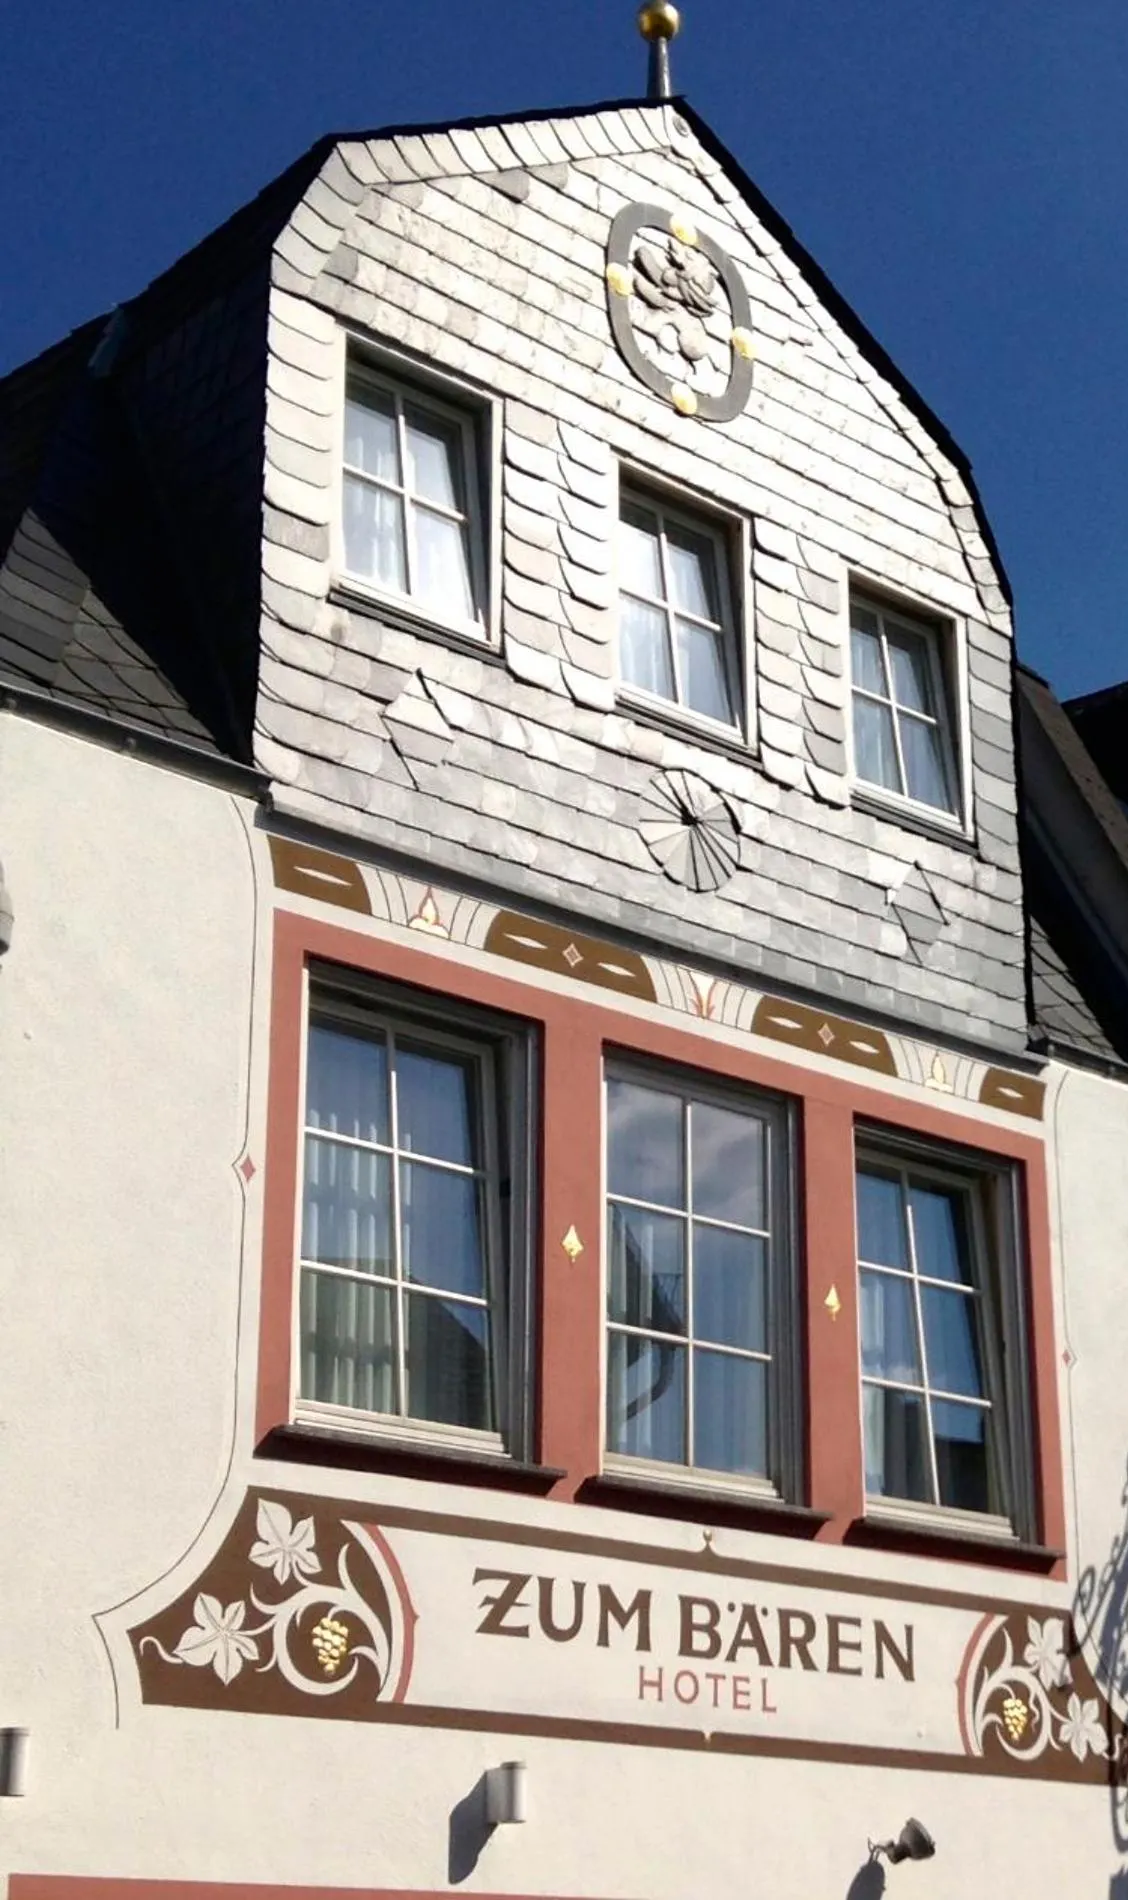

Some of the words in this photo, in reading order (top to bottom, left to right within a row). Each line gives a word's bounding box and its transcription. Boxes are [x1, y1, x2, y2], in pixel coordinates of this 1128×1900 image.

[472, 1567, 653, 1652] ZUM
[677, 1594, 915, 1682] BÄREN
[638, 1666, 777, 1713] HOTEL
